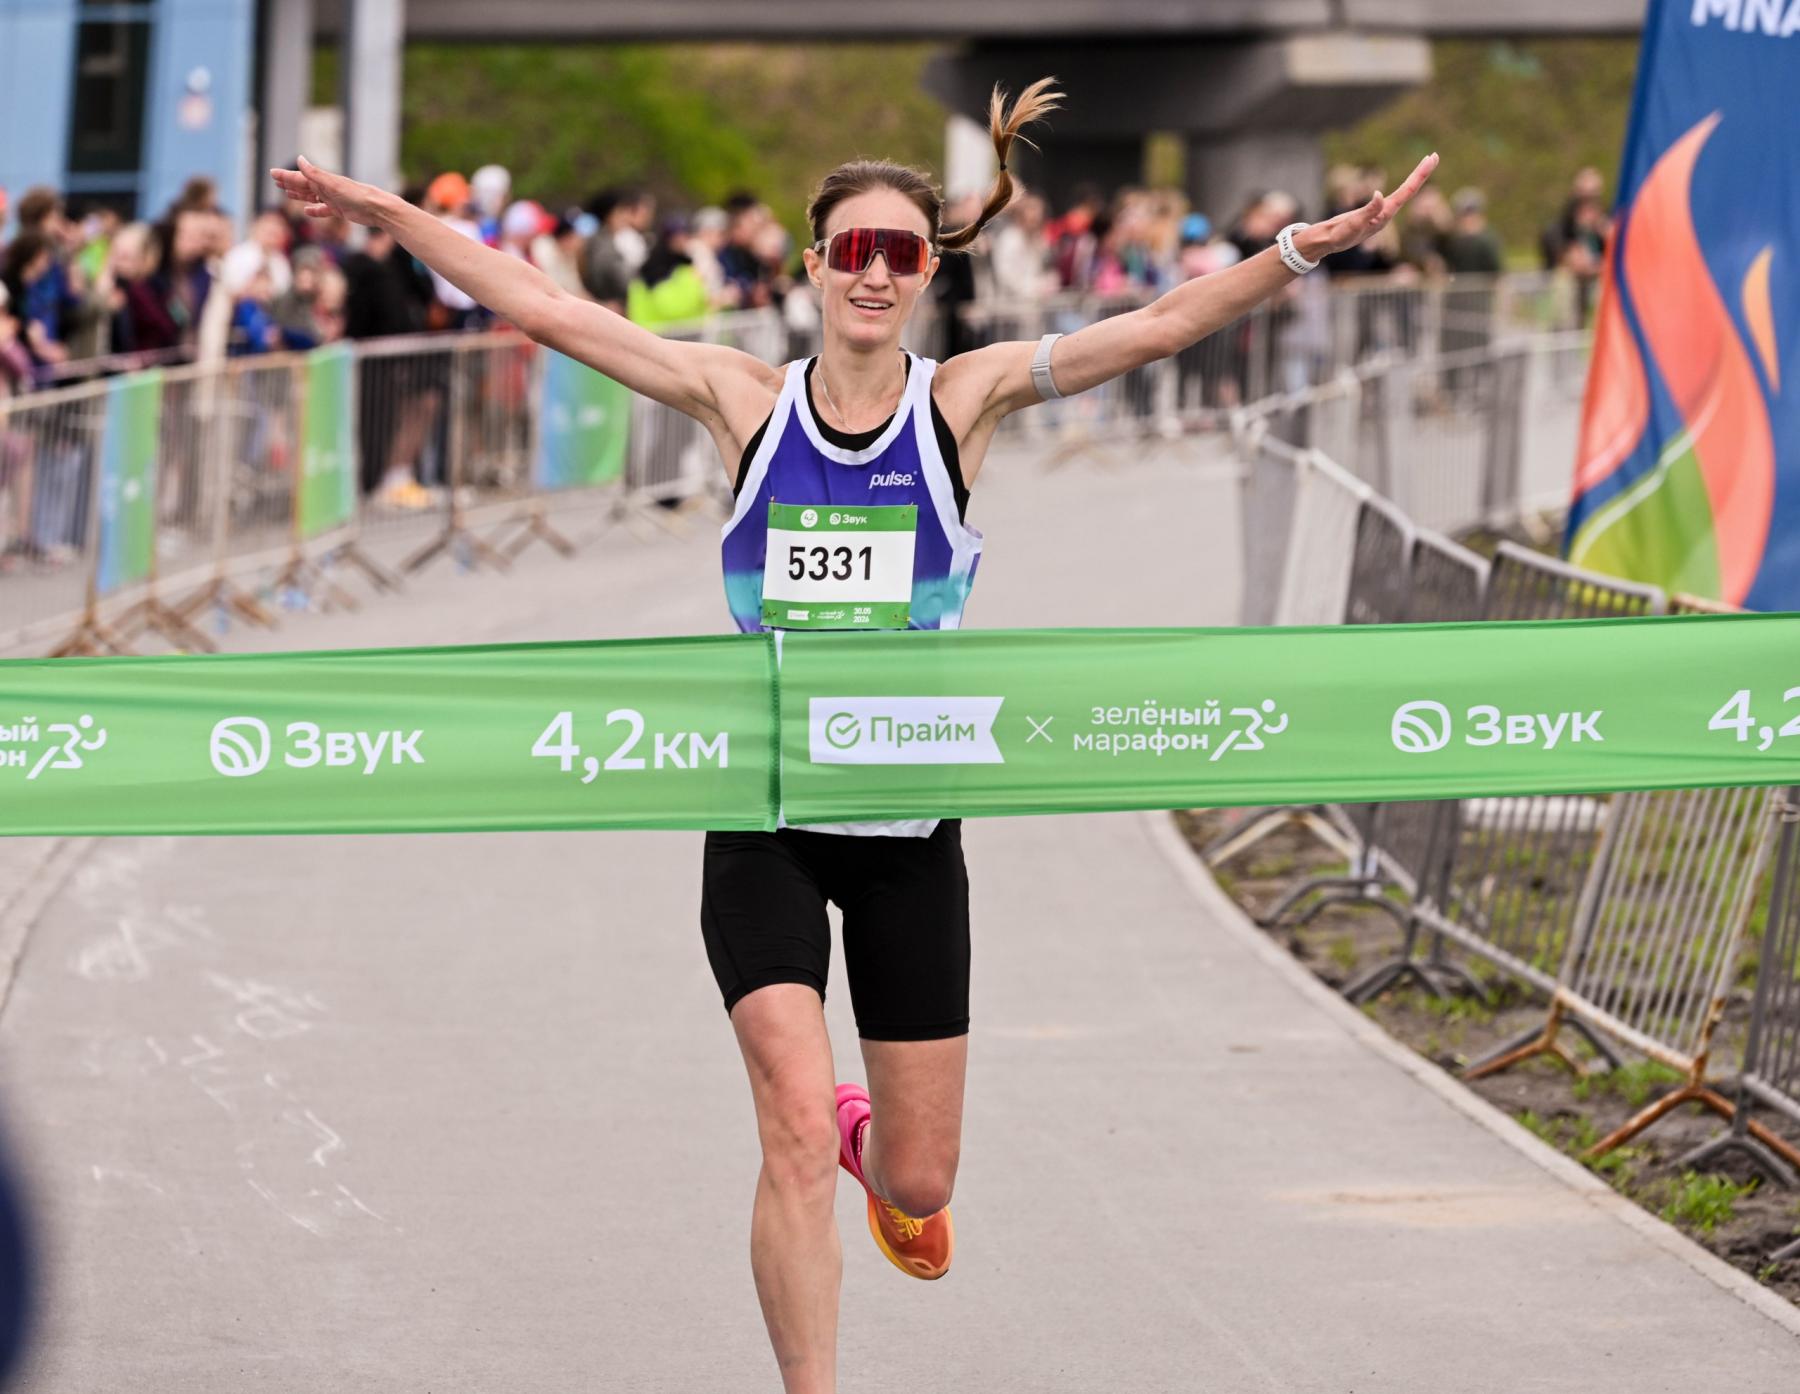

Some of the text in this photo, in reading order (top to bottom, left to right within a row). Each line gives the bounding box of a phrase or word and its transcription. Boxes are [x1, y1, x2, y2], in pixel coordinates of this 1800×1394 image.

[842, 513, 868, 526] Звук
[788, 546, 872, 581] 5331
[1091, 699, 1221, 726] зелёный
[1465, 704, 1604, 750] Звук
[284, 721, 425, 775] Звук
[870, 714, 976, 748] Прайм
[1073, 727, 1209, 756] марафон
